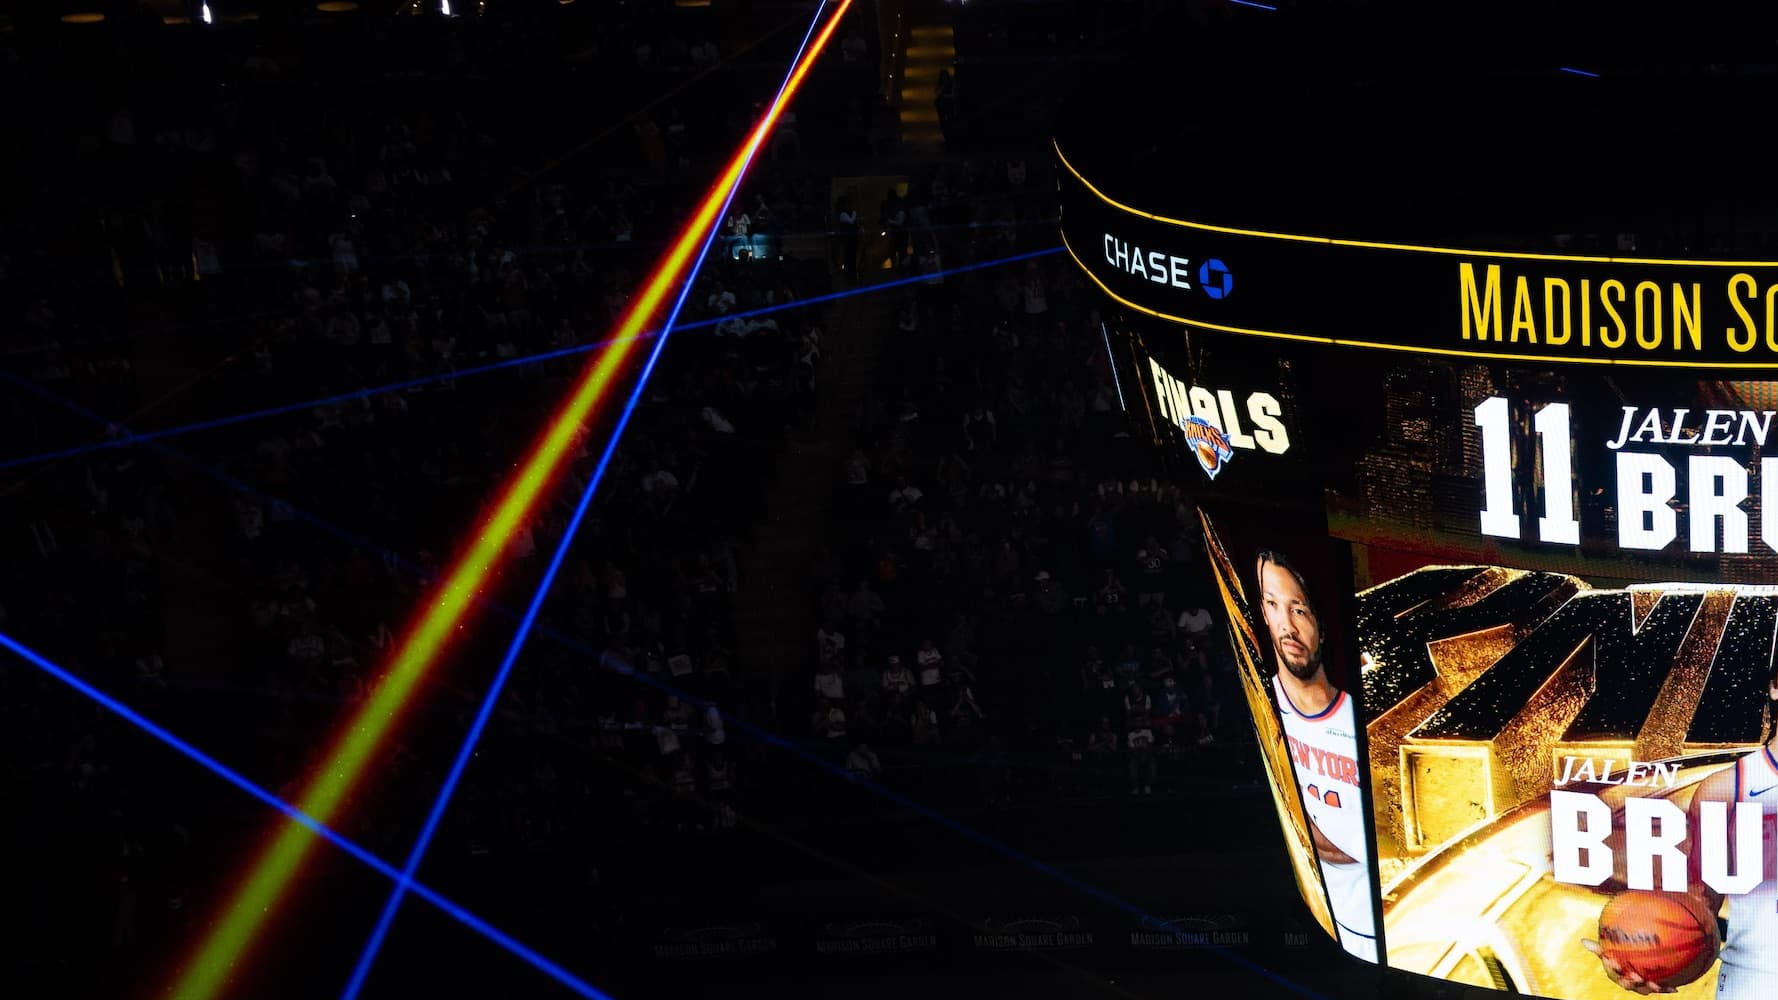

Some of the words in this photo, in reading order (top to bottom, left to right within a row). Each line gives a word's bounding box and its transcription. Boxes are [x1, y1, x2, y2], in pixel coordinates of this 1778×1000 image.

[1104, 233, 1192, 290] CHASE
[1459, 262, 1703, 351] MADISON
[1148, 356, 1291, 455] FINALS
[1474, 396, 1580, 545] 11
[1606, 405, 1777, 449] JALEN
[1310, 746, 1361, 789] YOR
[1553, 756, 1683, 789] JALEN
